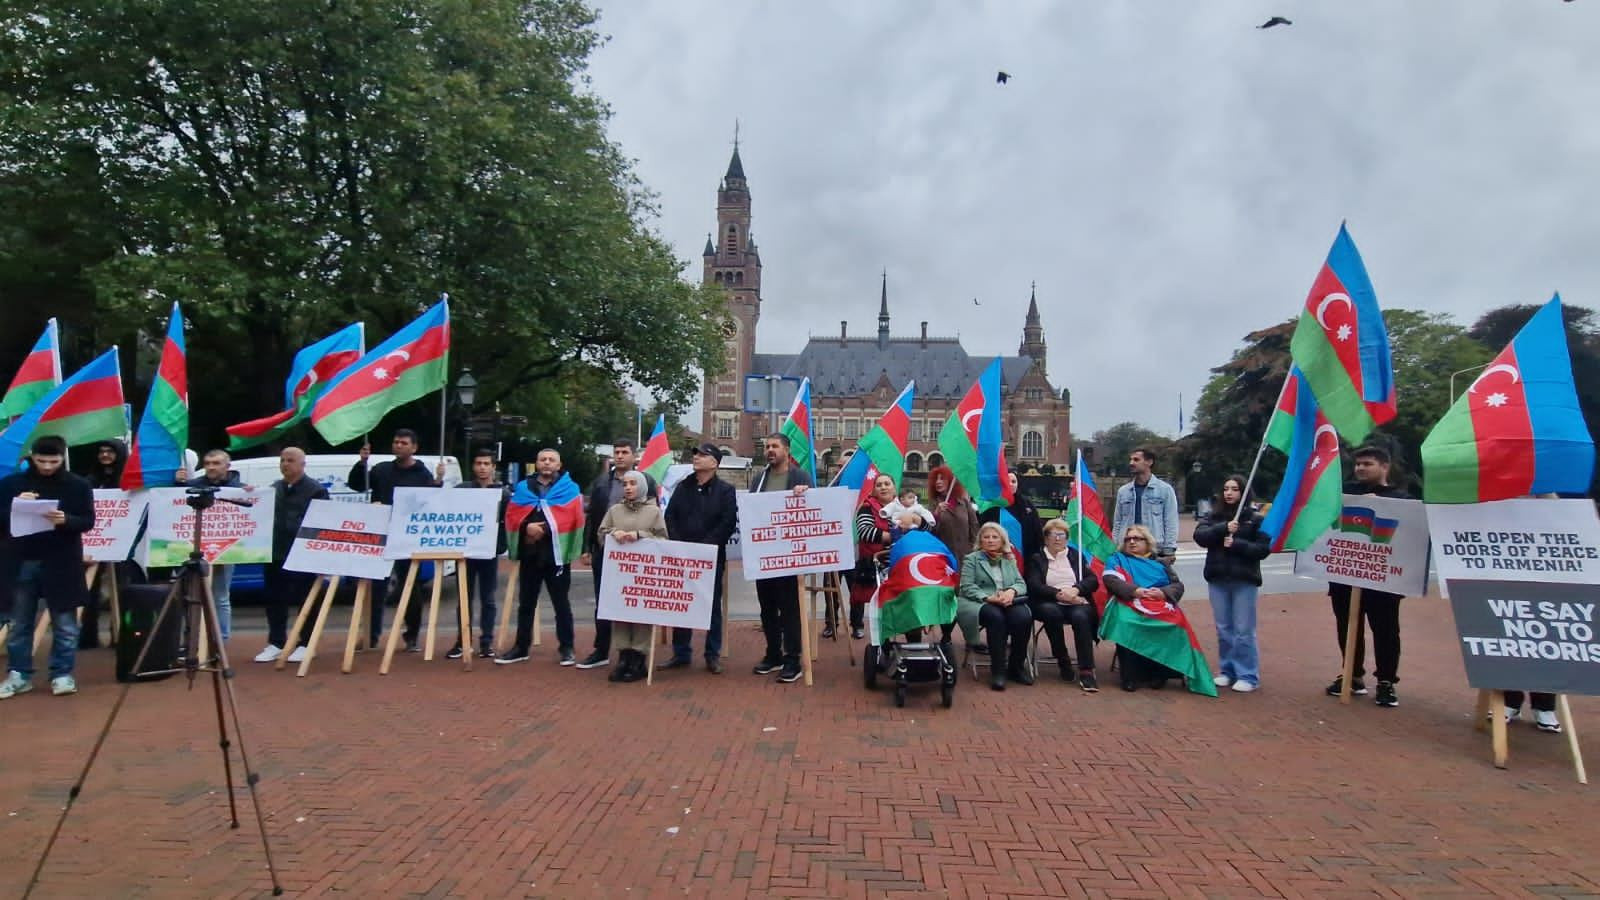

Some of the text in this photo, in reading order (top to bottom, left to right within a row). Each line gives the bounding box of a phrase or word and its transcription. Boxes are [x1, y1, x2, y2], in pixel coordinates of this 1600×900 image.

[785, 496, 806, 509] WE
[95, 509, 129, 517] RIOUS
[231, 513, 251, 521] THE
[410, 513, 483, 522] KARABAKH
[771, 510, 822, 524] DEMAND
[172, 522, 215, 530] RETRN
[341, 521, 365, 530] END
[406, 525, 484, 534] IS A WAY OF
[752, 522, 843, 541] THE PRINCIPLE
[196, 530, 254, 538] ARABAKH!
[1453, 532, 1580, 545] WE OPEN THE
[306, 541, 384, 556] SEPARATISM!
[420, 537, 467, 546] PEACE!
[792, 540, 807, 553] OF
[1327, 539, 1393, 554] AZERBAIJAN
[1330, 548, 1387, 563] SUPPORTS
[1443, 544, 1599, 559] DOORS OF PEACE
[608, 551, 713, 569] ARMENIA PREVENTS
[760, 552, 840, 570] RECIPROCITY!
[1314, 554, 1402, 576] COEXISTENCE IN
[1462, 558, 1583, 572] TO ARMENIA!
[618, 563, 702, 579] THE RETURN OF
[1326, 566, 1386, 582] GARABAGH
[634, 576, 684, 589] WESTERN
[621, 586, 694, 601] AZERBAIJANIS
[624, 598, 689, 612] TO YEREVAN
[1487, 599, 1595, 622] WE SAY
[1503, 619, 1593, 642] NO TO
[1463, 637, 1600, 663] TERRORIS
